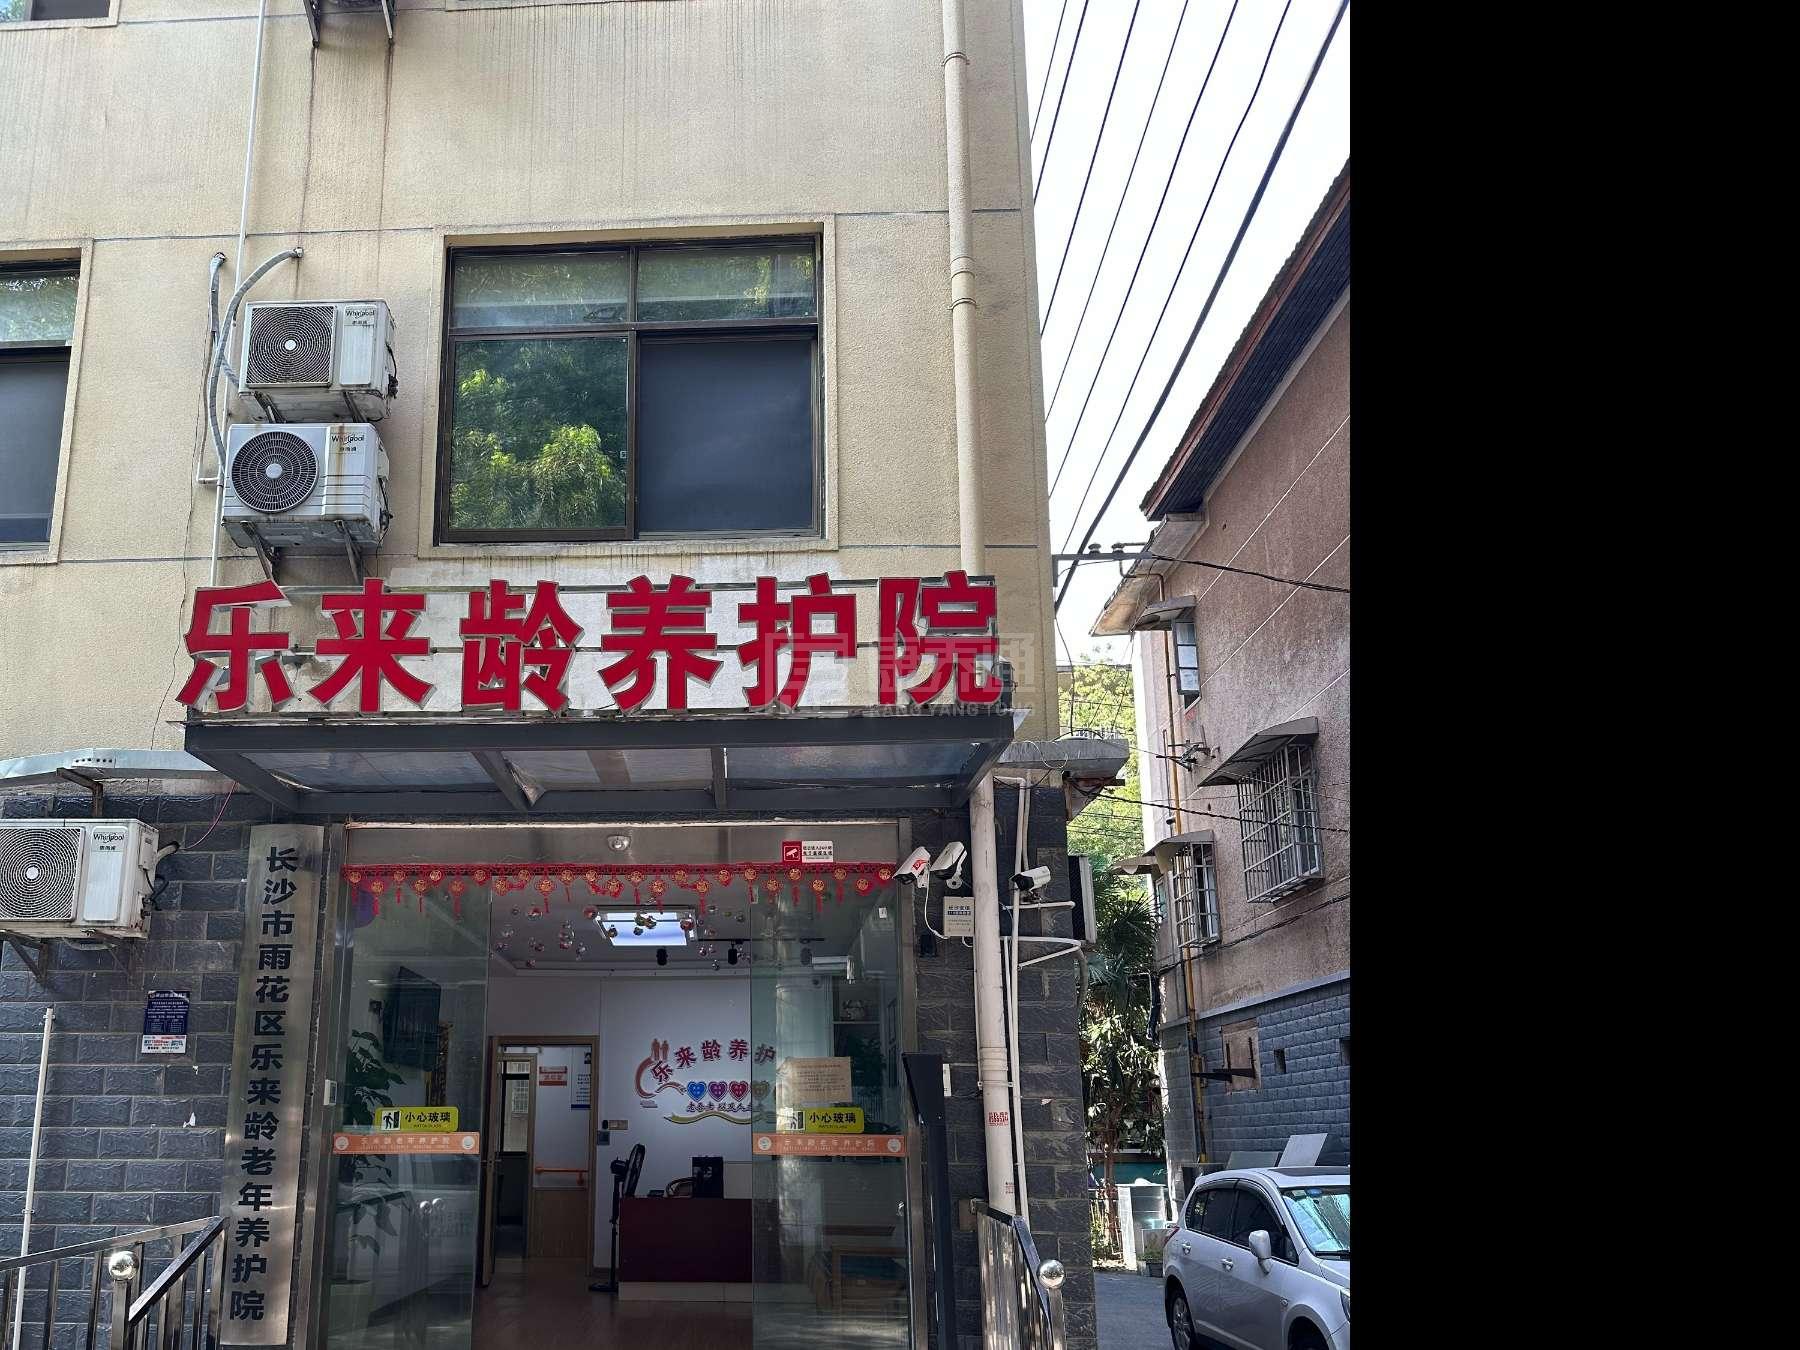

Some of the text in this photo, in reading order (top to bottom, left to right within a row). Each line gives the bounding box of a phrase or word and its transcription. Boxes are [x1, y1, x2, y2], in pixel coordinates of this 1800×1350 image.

[176, 570, 1002, 715] 乐来龄养护院
[93, 833, 125, 842] Whirlpool
[229, 846, 299, 1322] 长沙市雨花区乐来龄老年养护院
[405, 1111, 451, 1123] 小心玻璃
[809, 1111, 857, 1124] 小心玻璃
